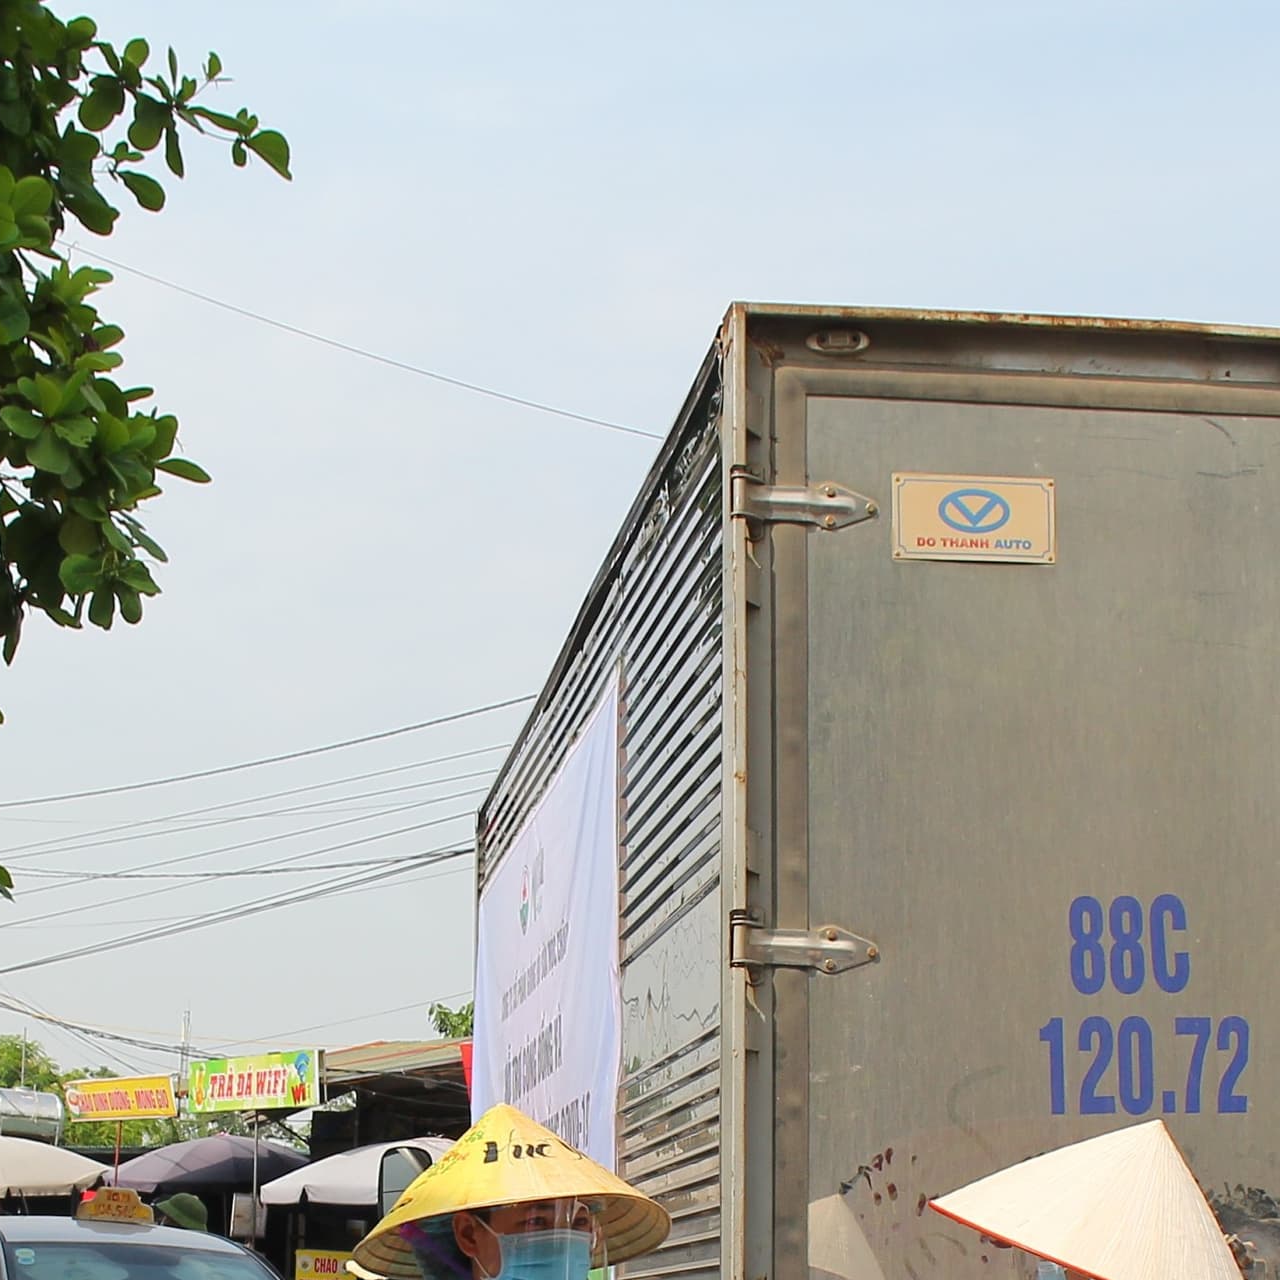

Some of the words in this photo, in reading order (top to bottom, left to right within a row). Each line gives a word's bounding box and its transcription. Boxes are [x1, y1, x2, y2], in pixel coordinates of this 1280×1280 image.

[917, 537, 936, 547] DO
[940, 538, 989, 548] THANH
[995, 539, 1032, 550] AUTO
[1069, 893, 1190, 995] 88C
[1039, 1015, 1250, 1116] 120.72
